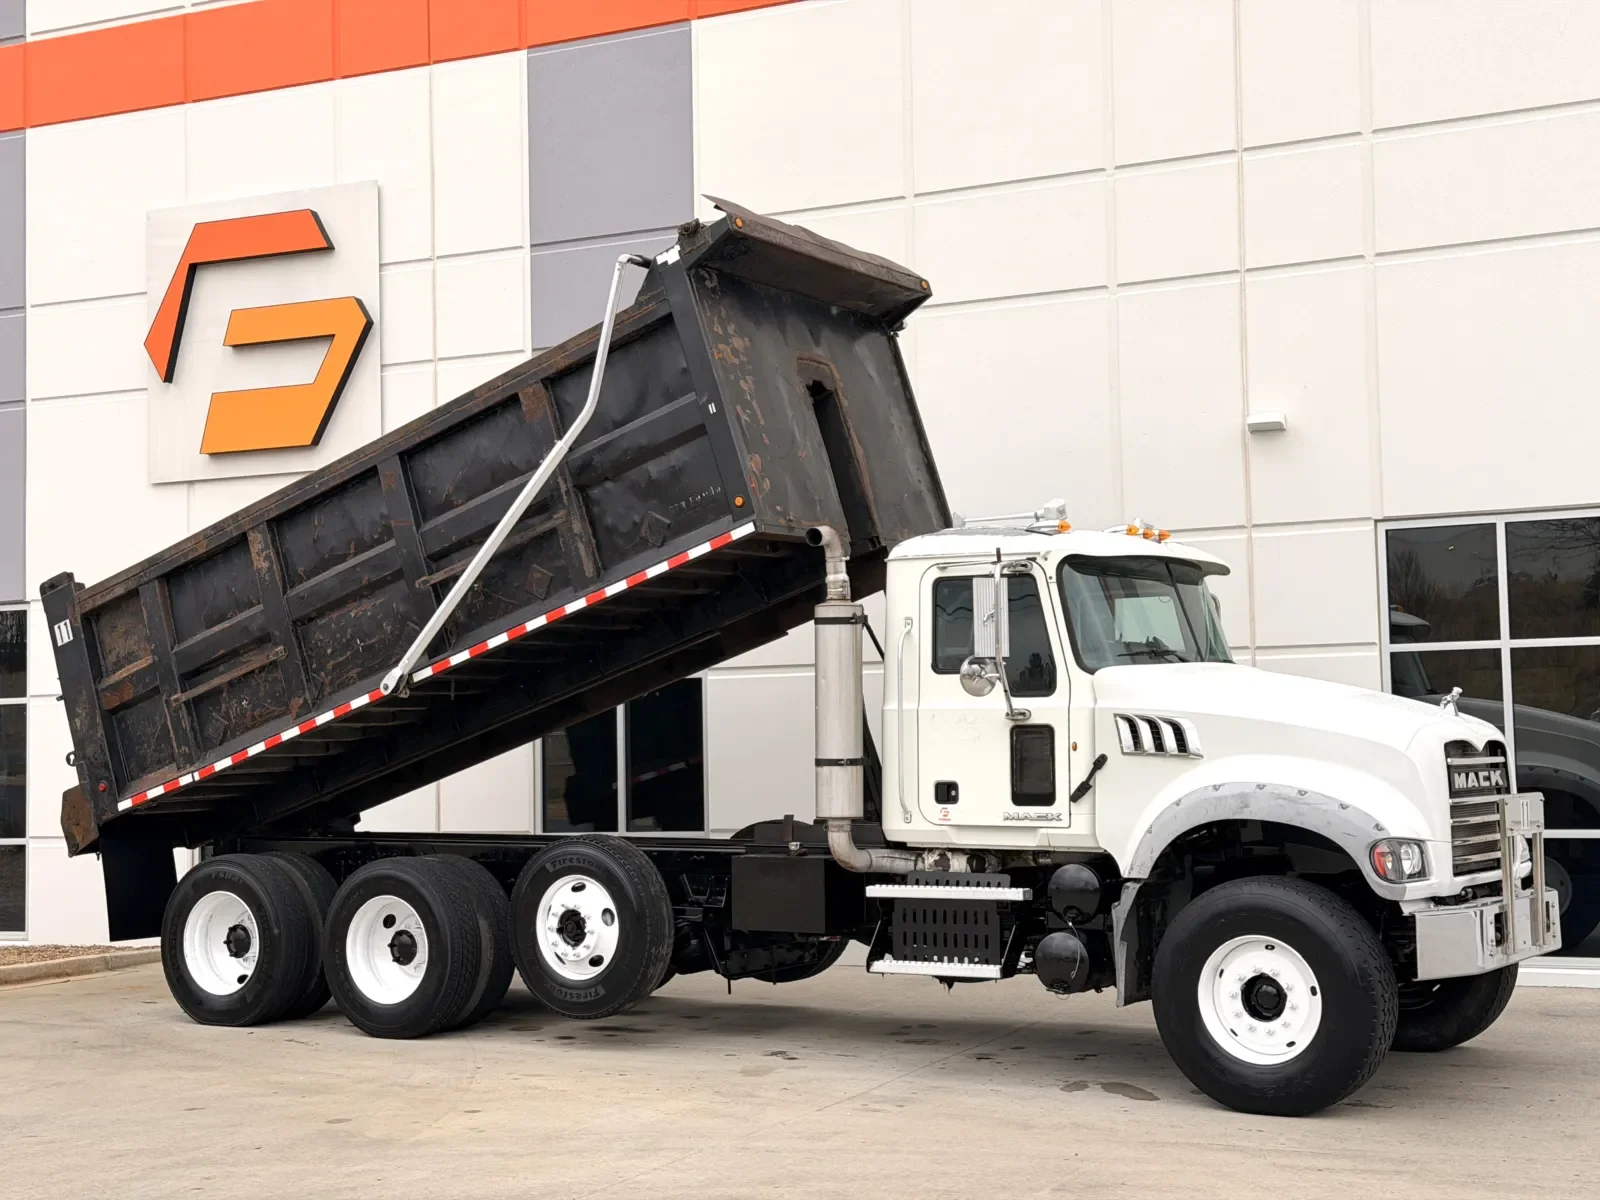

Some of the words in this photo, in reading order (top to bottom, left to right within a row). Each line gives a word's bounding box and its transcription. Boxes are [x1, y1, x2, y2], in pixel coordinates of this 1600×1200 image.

[57, 621, 71, 643] 11
[1454, 770, 1503, 788] MACK
[1003, 812, 1062, 822] MACK
[544, 980, 601, 1001] Firesto
